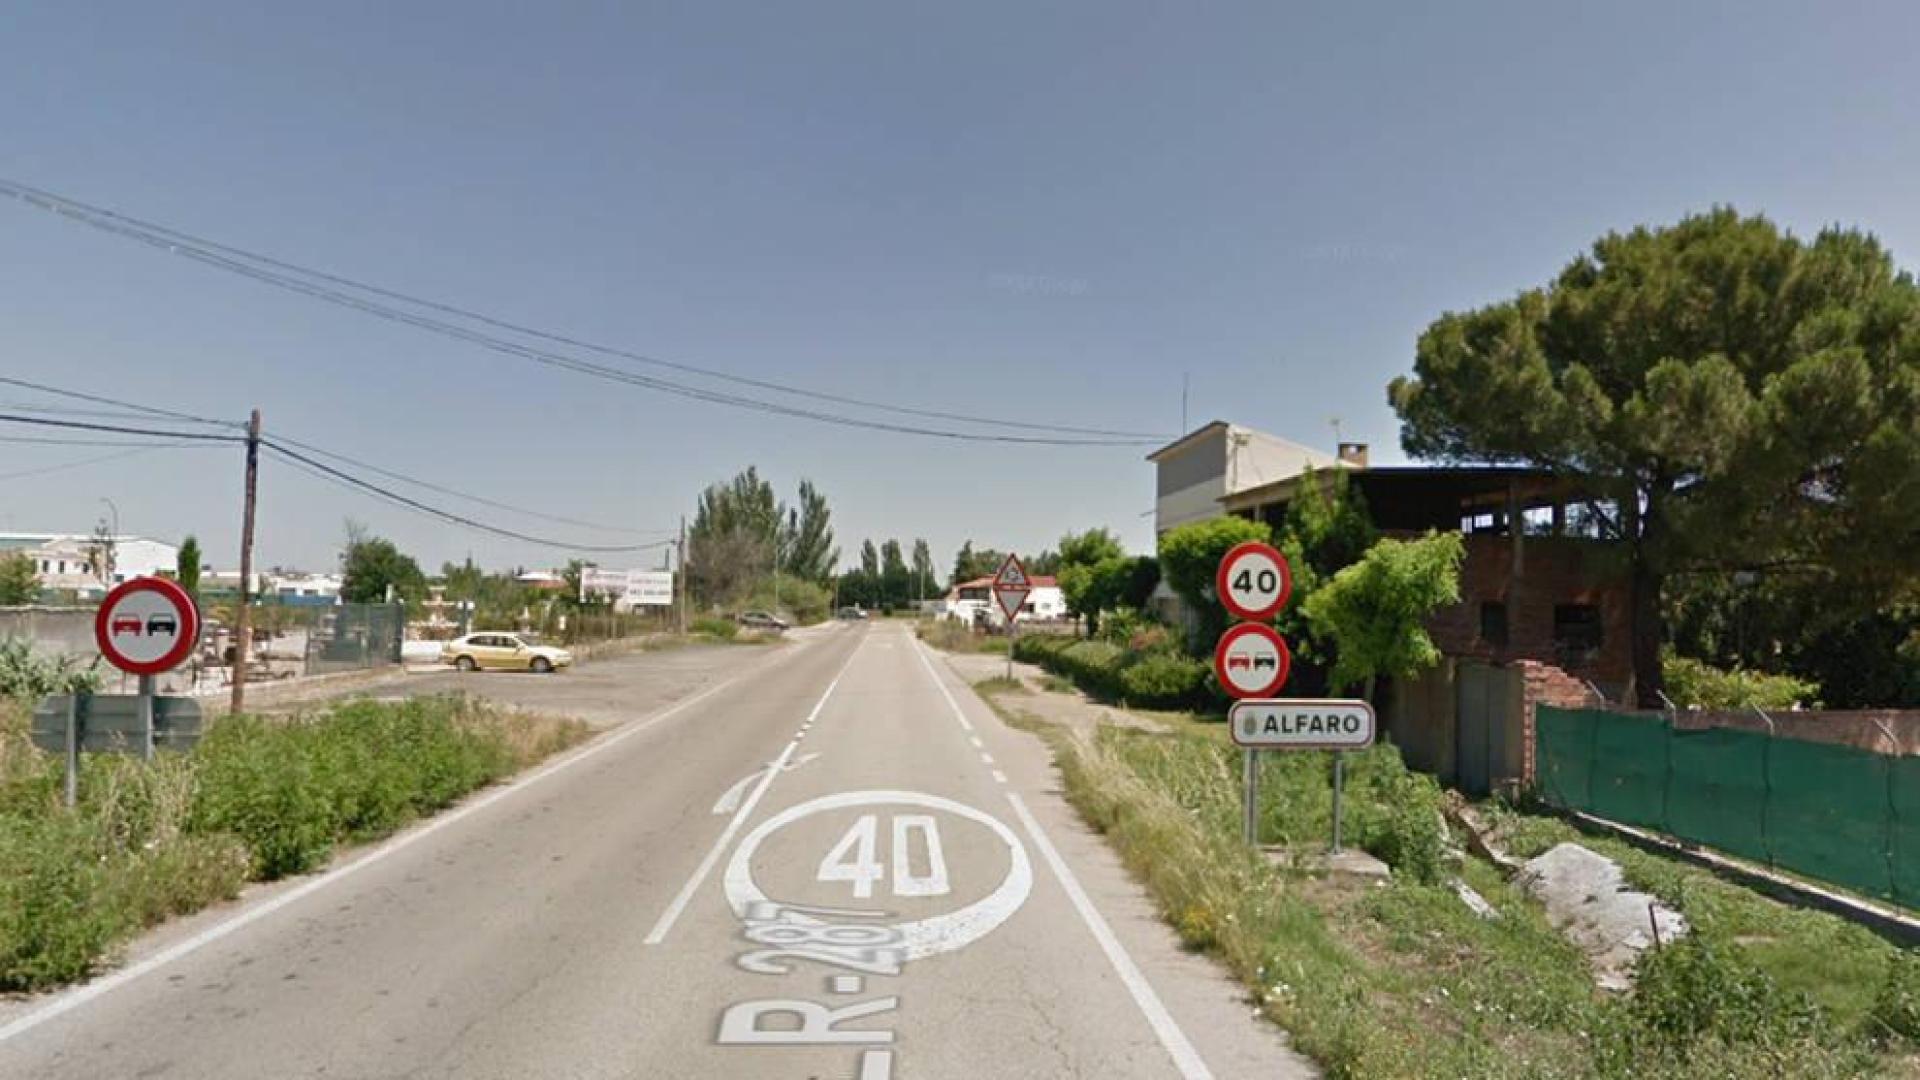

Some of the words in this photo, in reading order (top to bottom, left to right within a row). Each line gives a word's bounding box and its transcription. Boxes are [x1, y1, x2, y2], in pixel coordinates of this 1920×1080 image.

[1232, 569, 1277, 594] 40
[1263, 714, 1361, 734] ALFARO
[817, 814, 951, 898] 40
